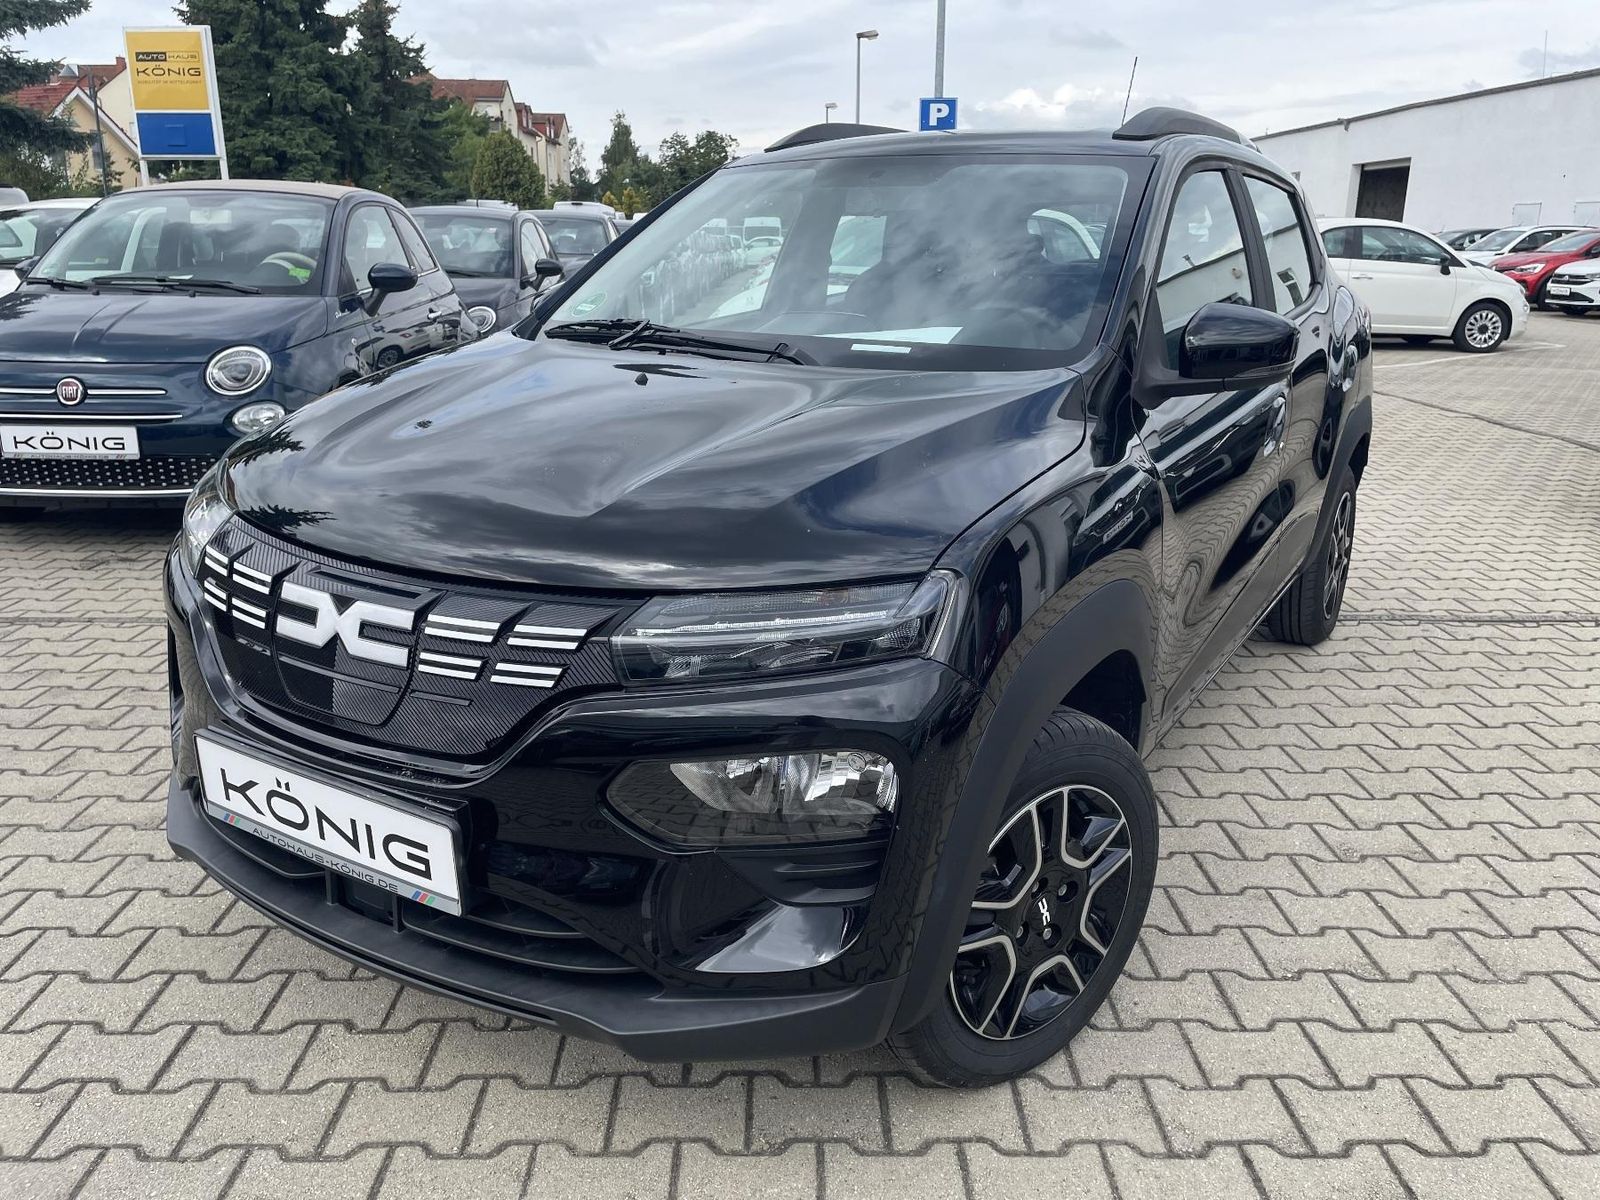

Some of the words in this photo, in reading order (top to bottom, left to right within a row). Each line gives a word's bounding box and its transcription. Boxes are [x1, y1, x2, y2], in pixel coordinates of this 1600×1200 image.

[136, 64, 201, 77] KÖNIG
[929, 103, 950, 126] P
[62, 385, 79, 399] FIAT
[13, 431, 126, 450] KÖNIG
[220, 767, 433, 881] KÖNIG
[252, 826, 399, 892] AUTOHAUS-KÖNIG.DE
